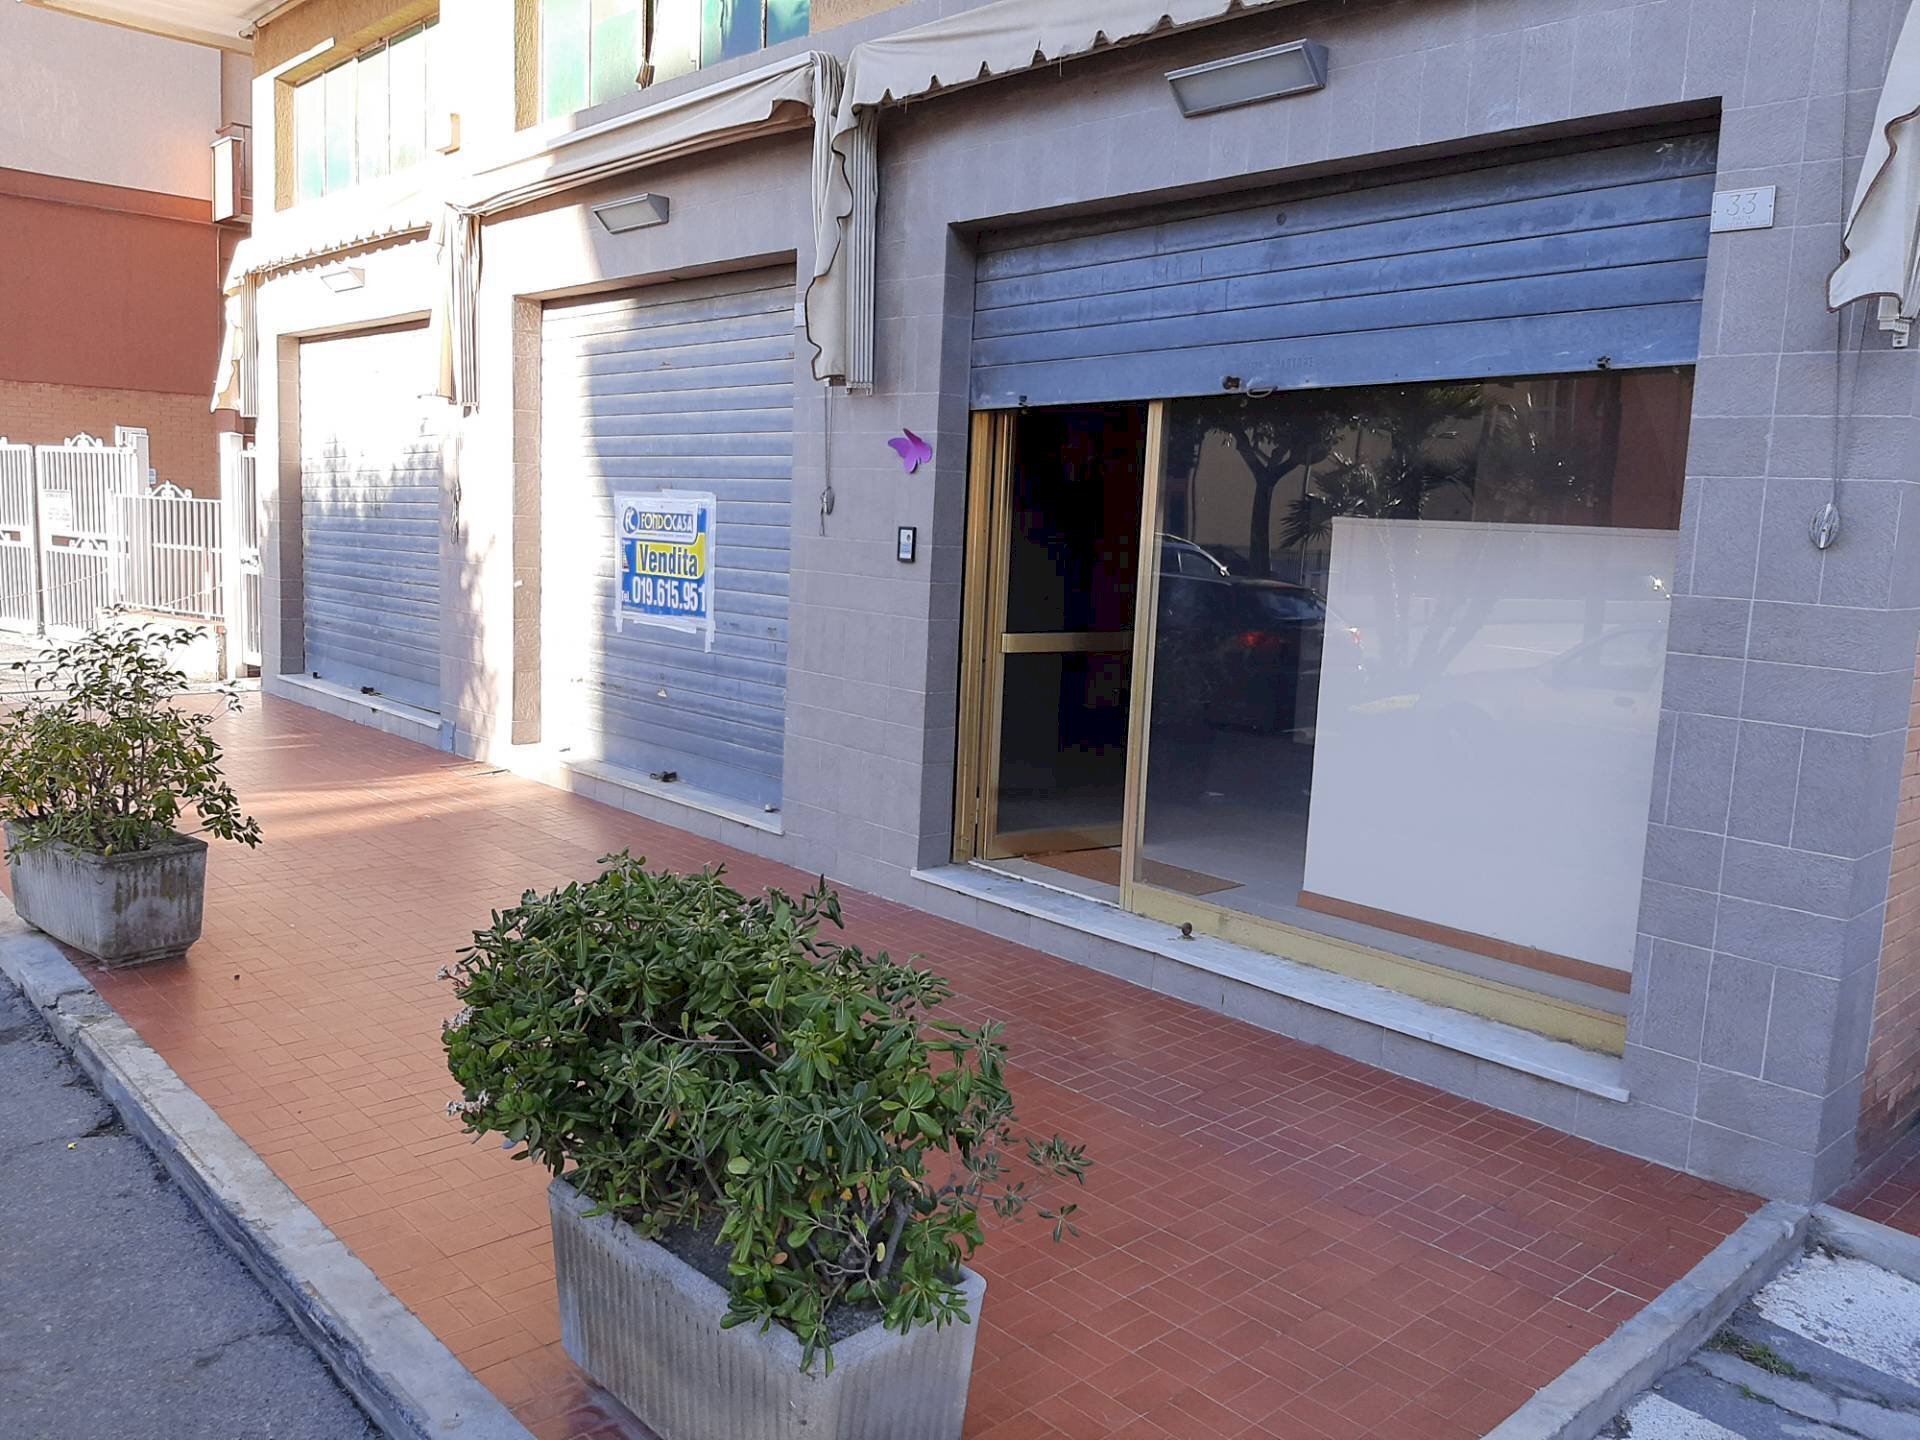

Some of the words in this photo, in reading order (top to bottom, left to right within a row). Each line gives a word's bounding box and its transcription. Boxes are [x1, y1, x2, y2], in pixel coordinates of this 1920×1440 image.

[1726, 192, 1758, 216] 33
[641, 514, 693, 532] FONDOCASA
[639, 543, 698, 577] Vendita
[632, 576, 706, 611] 019.615.951
